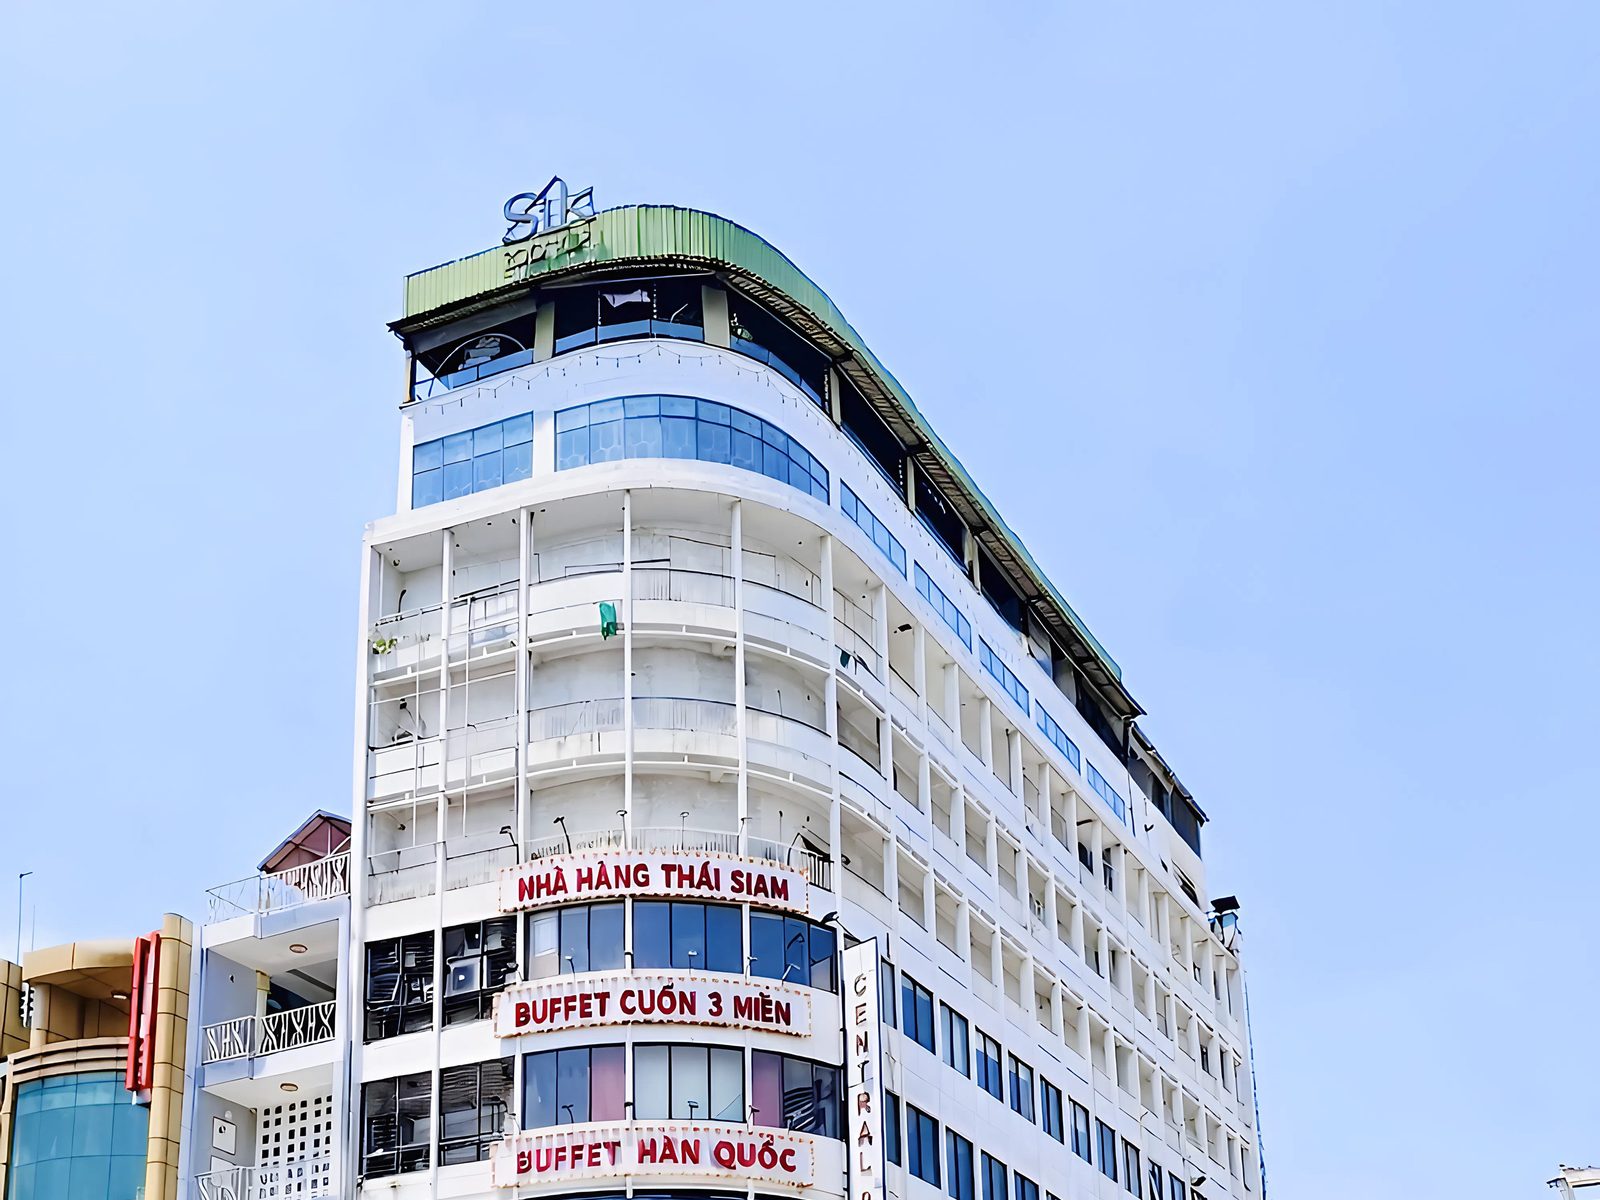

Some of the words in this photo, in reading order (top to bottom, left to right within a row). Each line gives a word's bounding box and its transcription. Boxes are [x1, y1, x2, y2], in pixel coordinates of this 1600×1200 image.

[518, 865, 568, 902] NHÀ
[576, 860, 650, 892] HÀNG
[660, 860, 720, 891] THÁI
[730, 869, 789, 901] SIAM
[515, 991, 610, 1028] BUFFET
[619, 981, 697, 1016] CUỐN
[708, 991, 723, 1017] 3
[853, 974, 874, 1173] CENTRAL
[516, 1140, 621, 1175] BUFFET
[637, 1134, 700, 1165] HÀN
[713, 1134, 797, 1173] QUỐC
